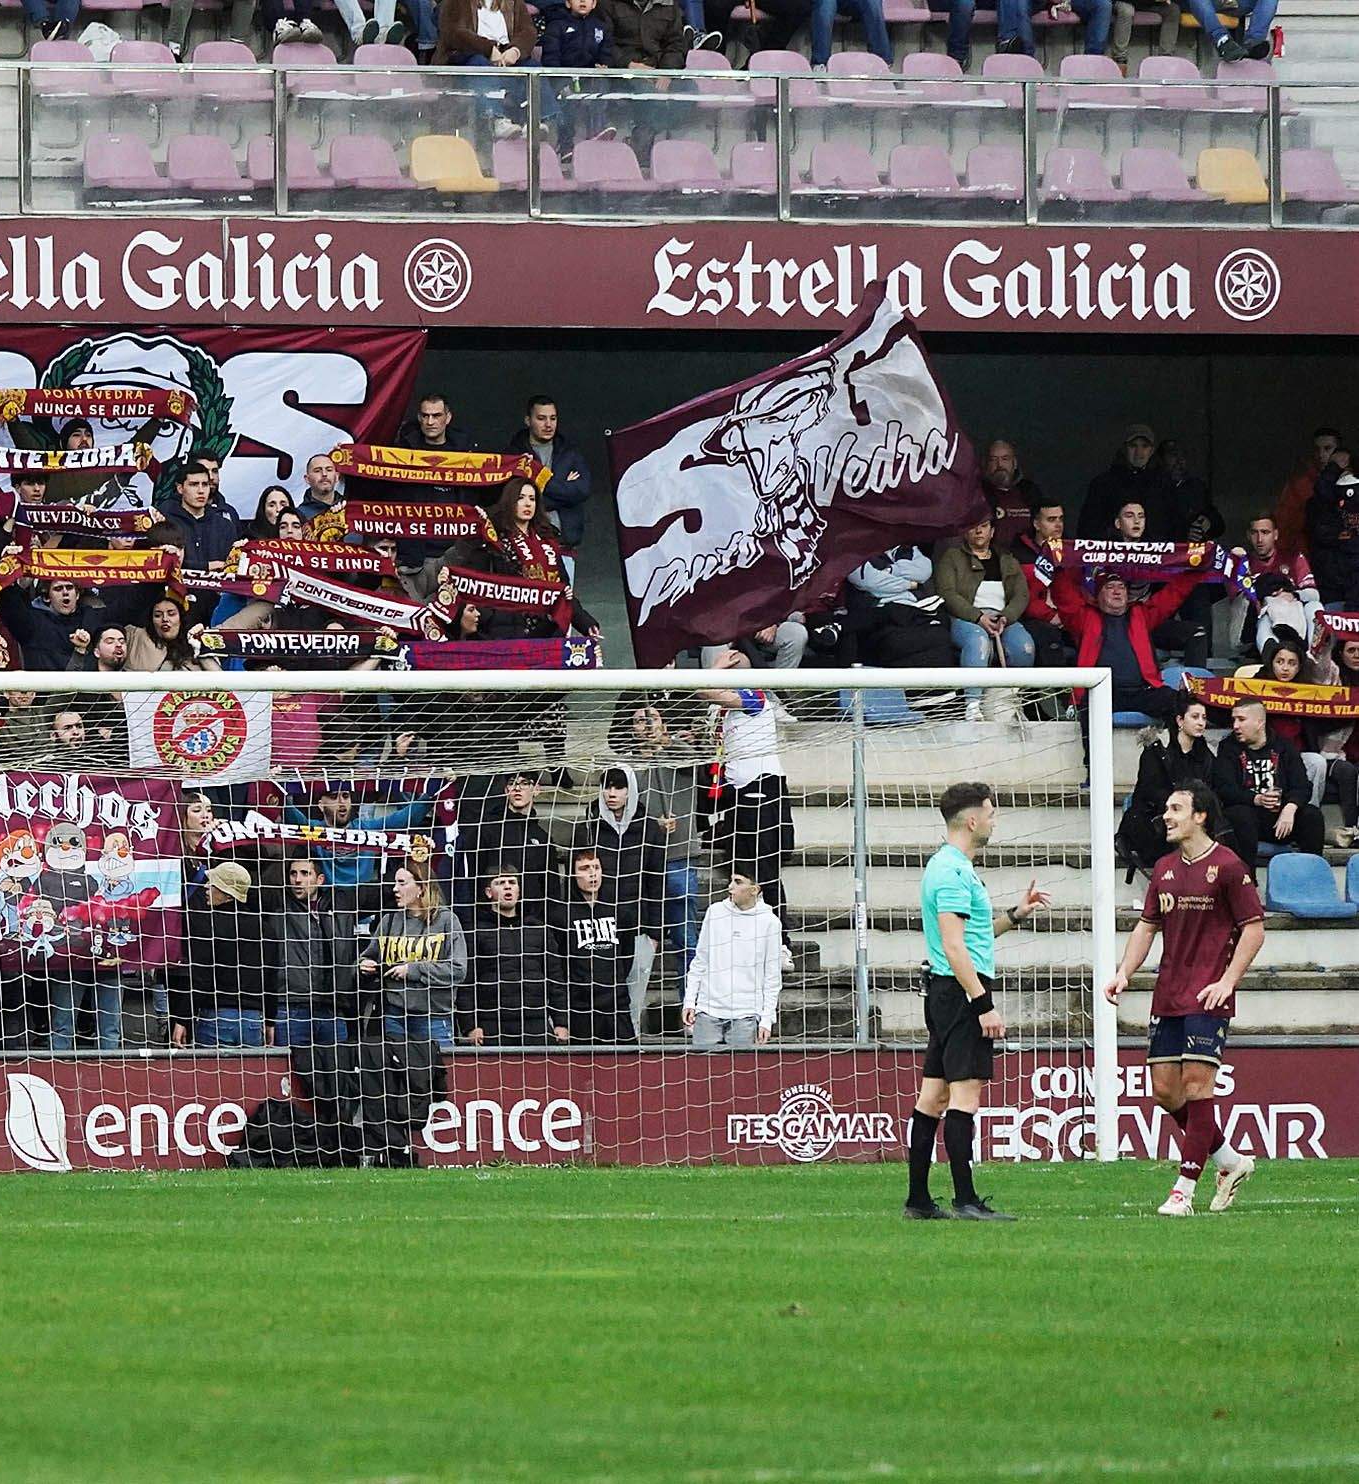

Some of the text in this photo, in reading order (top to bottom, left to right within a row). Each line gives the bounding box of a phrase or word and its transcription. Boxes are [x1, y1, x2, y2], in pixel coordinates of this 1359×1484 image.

[121, 230, 384, 312] Galicia
[943, 239, 1195, 320] Galicia
[43, 389, 144, 400] PONTEVEDRA
[34, 402, 155, 416] NUNCA SE RINDE
[357, 463, 442, 481] PONTEVEDRA
[456, 470, 482, 482] BOA
[814, 420, 959, 507] Vedra
[362, 504, 466, 519] PONTEVEDRA
[354, 519, 478, 536] NUNCA SE RINDE
[258, 540, 369, 555] PONTEVEDRA
[310, 557, 329, 569] SE
[335, 558, 381, 572] RINDE
[1082, 552, 1101, 563] CLUB
[1127, 552, 1162, 565] FUTBOL
[22, 566, 106, 580] PONTEVEDRA
[119, 570, 144, 580] BOA
[146, 569, 167, 580] VIL
[450, 575, 561, 606] PONTEVEDRA CF
[295, 580, 405, 620] PONTEVEDRA CF
[238, 633, 360, 651] PONTEVEDRA
[1306, 704, 1331, 715] BOA
[1031, 1065, 1236, 1100] CONSES
[780, 1084, 833, 1102] CONSERVAS
[85, 1102, 248, 1158] ence
[421, 1098, 583, 1153] ence
[727, 1112, 897, 1144] PESCAMAR
[907, 1103, 1329, 1162] ESCAAR
